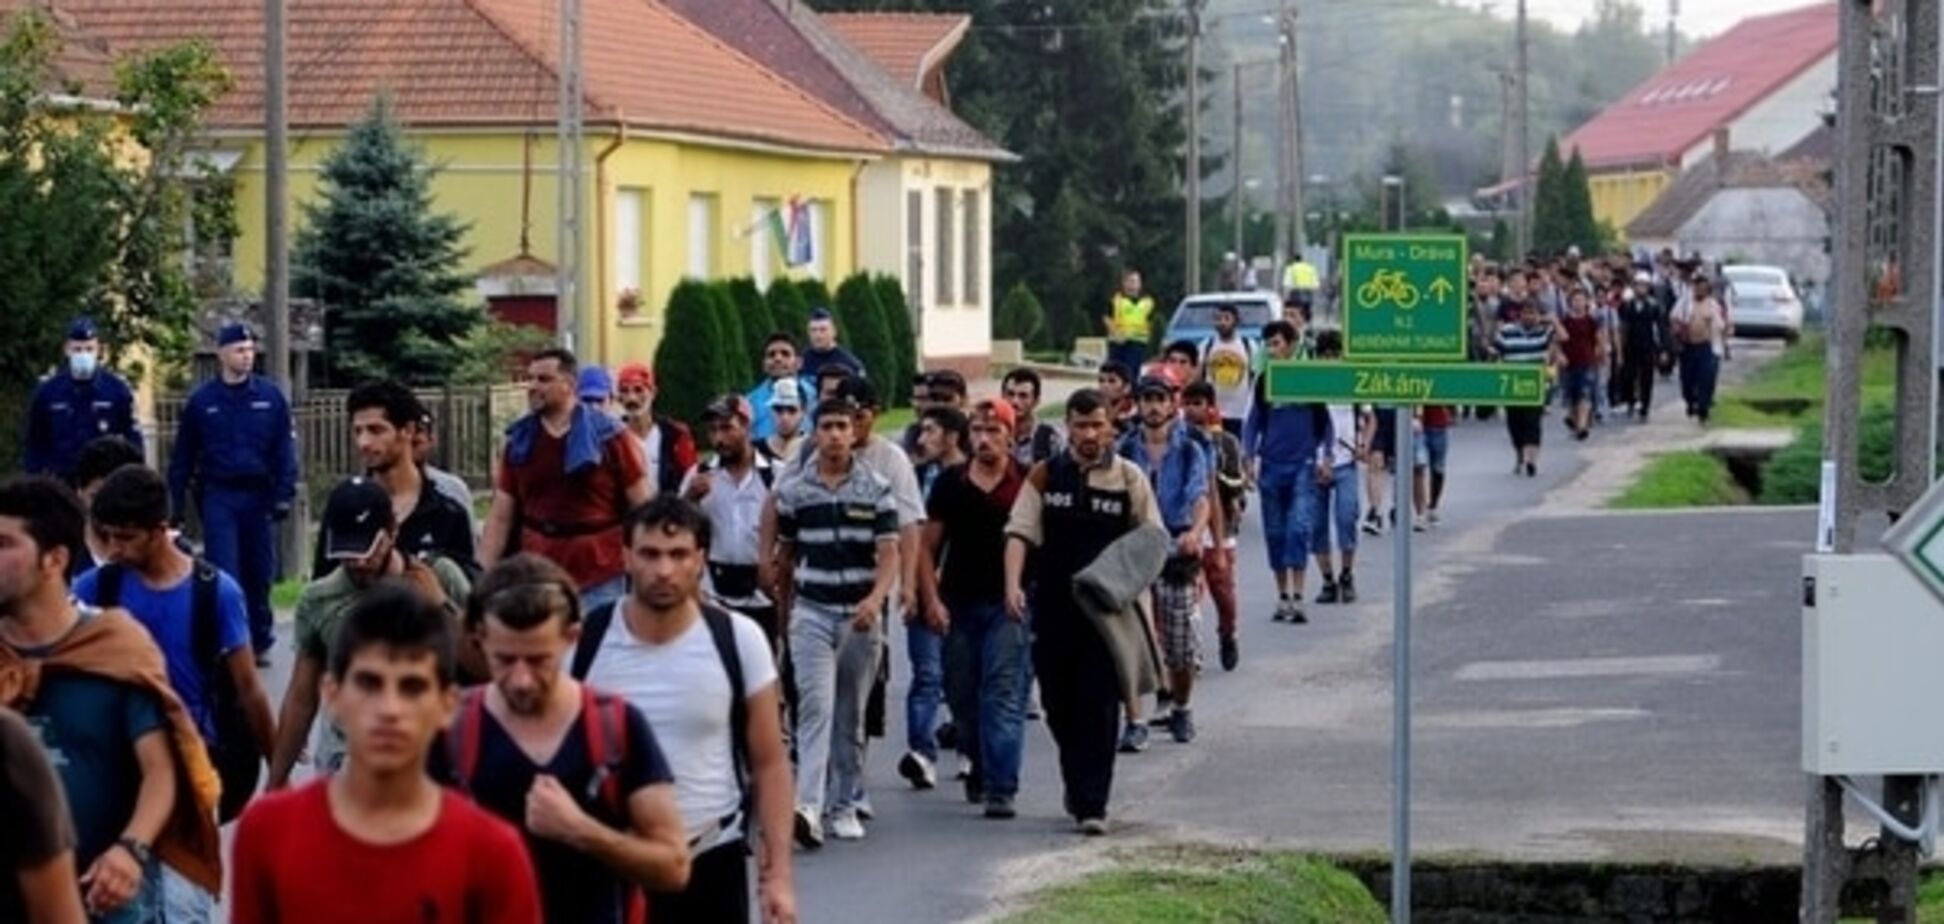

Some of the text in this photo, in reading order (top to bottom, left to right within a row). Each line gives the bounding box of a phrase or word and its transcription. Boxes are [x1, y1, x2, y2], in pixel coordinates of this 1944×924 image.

[1354, 245, 1394, 260] Mura
[1409, 245, 1455, 260] Dráva
[1353, 371, 1536, 400] Zákány 7 km
